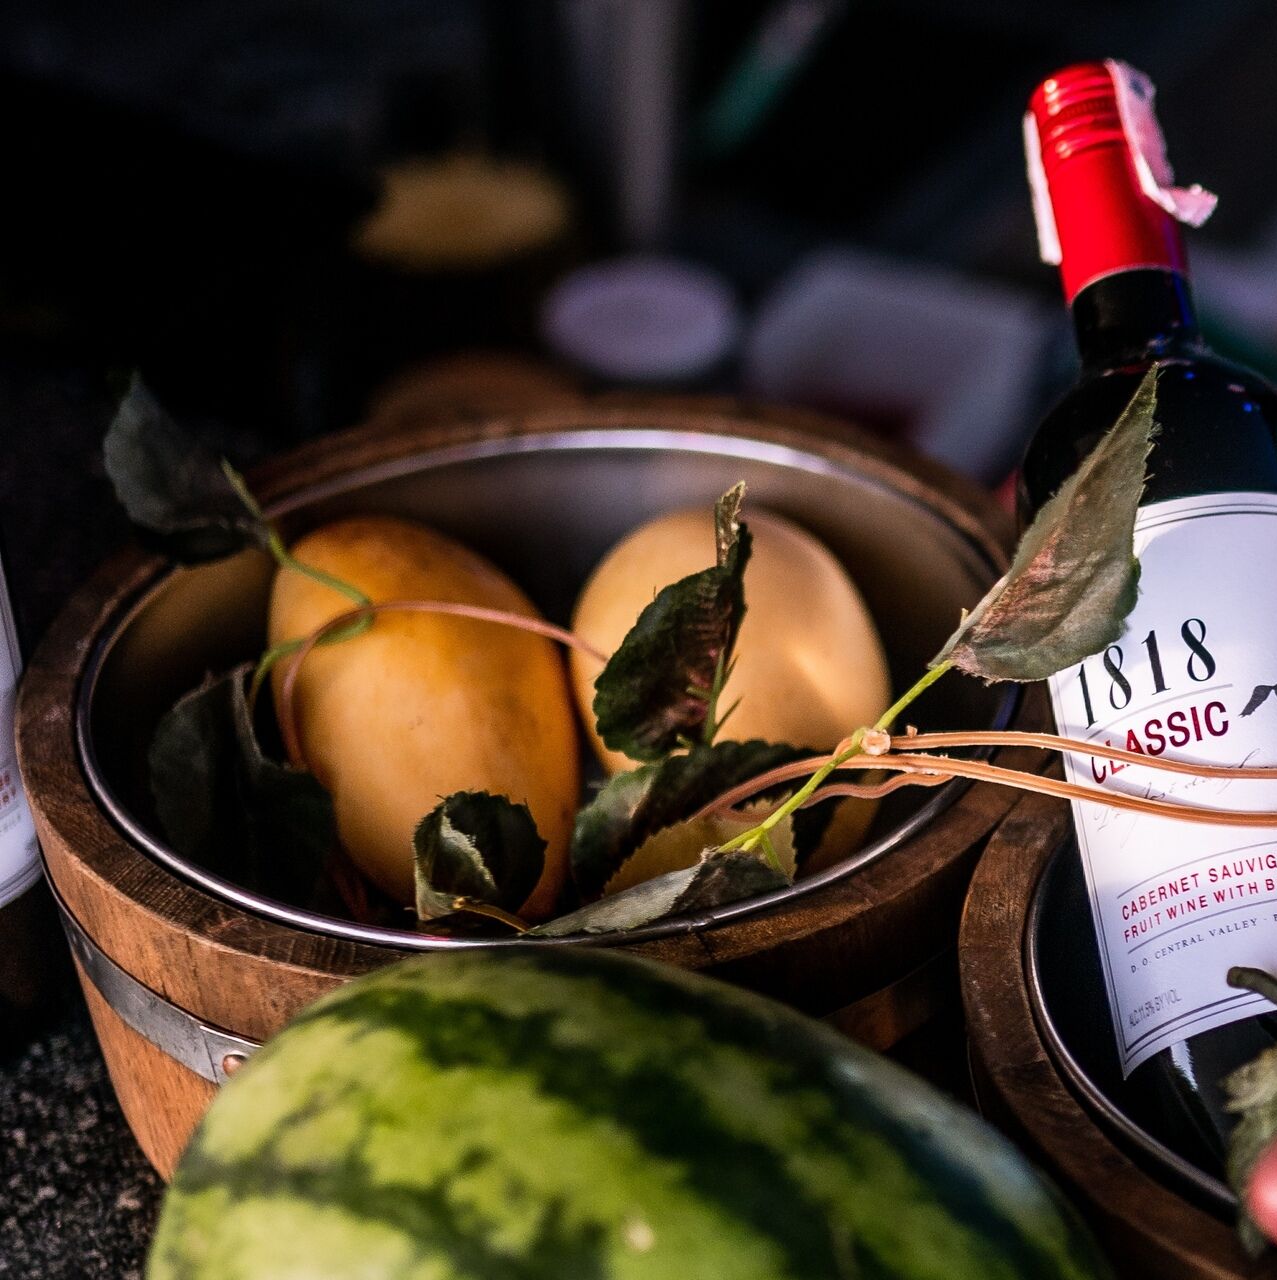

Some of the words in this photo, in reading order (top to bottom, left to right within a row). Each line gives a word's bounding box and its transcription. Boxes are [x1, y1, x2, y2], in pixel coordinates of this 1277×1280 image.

[1077, 618, 1217, 730] 1818
[1122, 873, 1200, 921] CABERNET
[1124, 912, 1162, 944] FRUIT
[1166, 895, 1208, 921] WINE
[1213, 881, 1259, 904] WITH
[1154, 934, 1204, 960] CENTRAL
[1208, 918, 1257, 937] VALLEY
